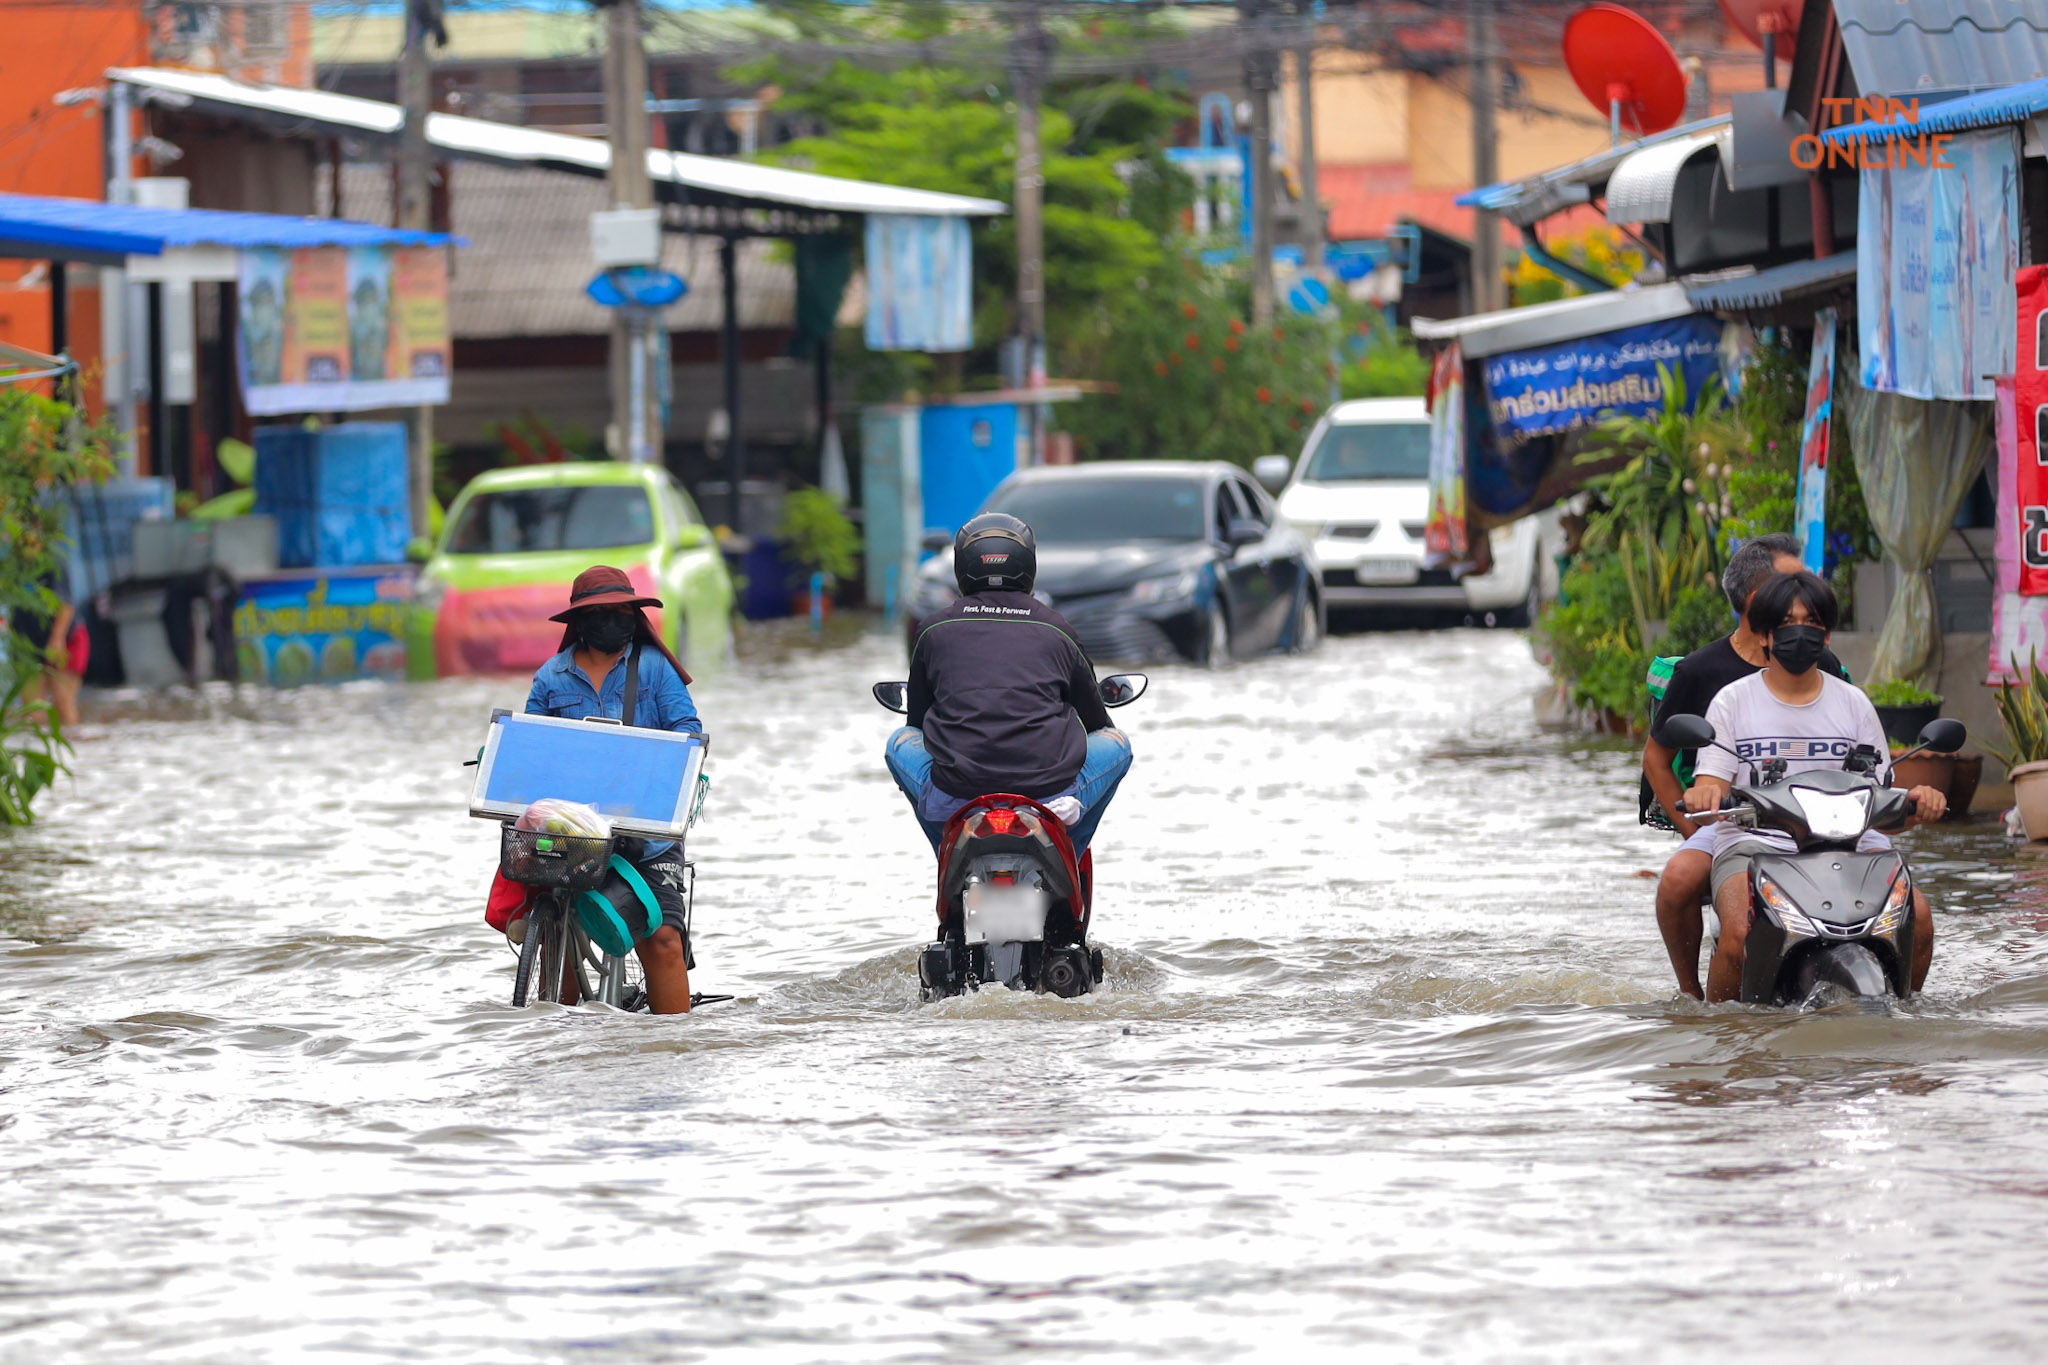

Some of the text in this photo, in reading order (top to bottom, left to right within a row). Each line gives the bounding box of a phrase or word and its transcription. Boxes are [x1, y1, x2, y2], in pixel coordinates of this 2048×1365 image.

[980, 605, 996, 613] Fast
[995, 606, 1002, 614] &
[1002, 607, 1031, 616] Forward
[1736, 741, 1777, 757] BH
